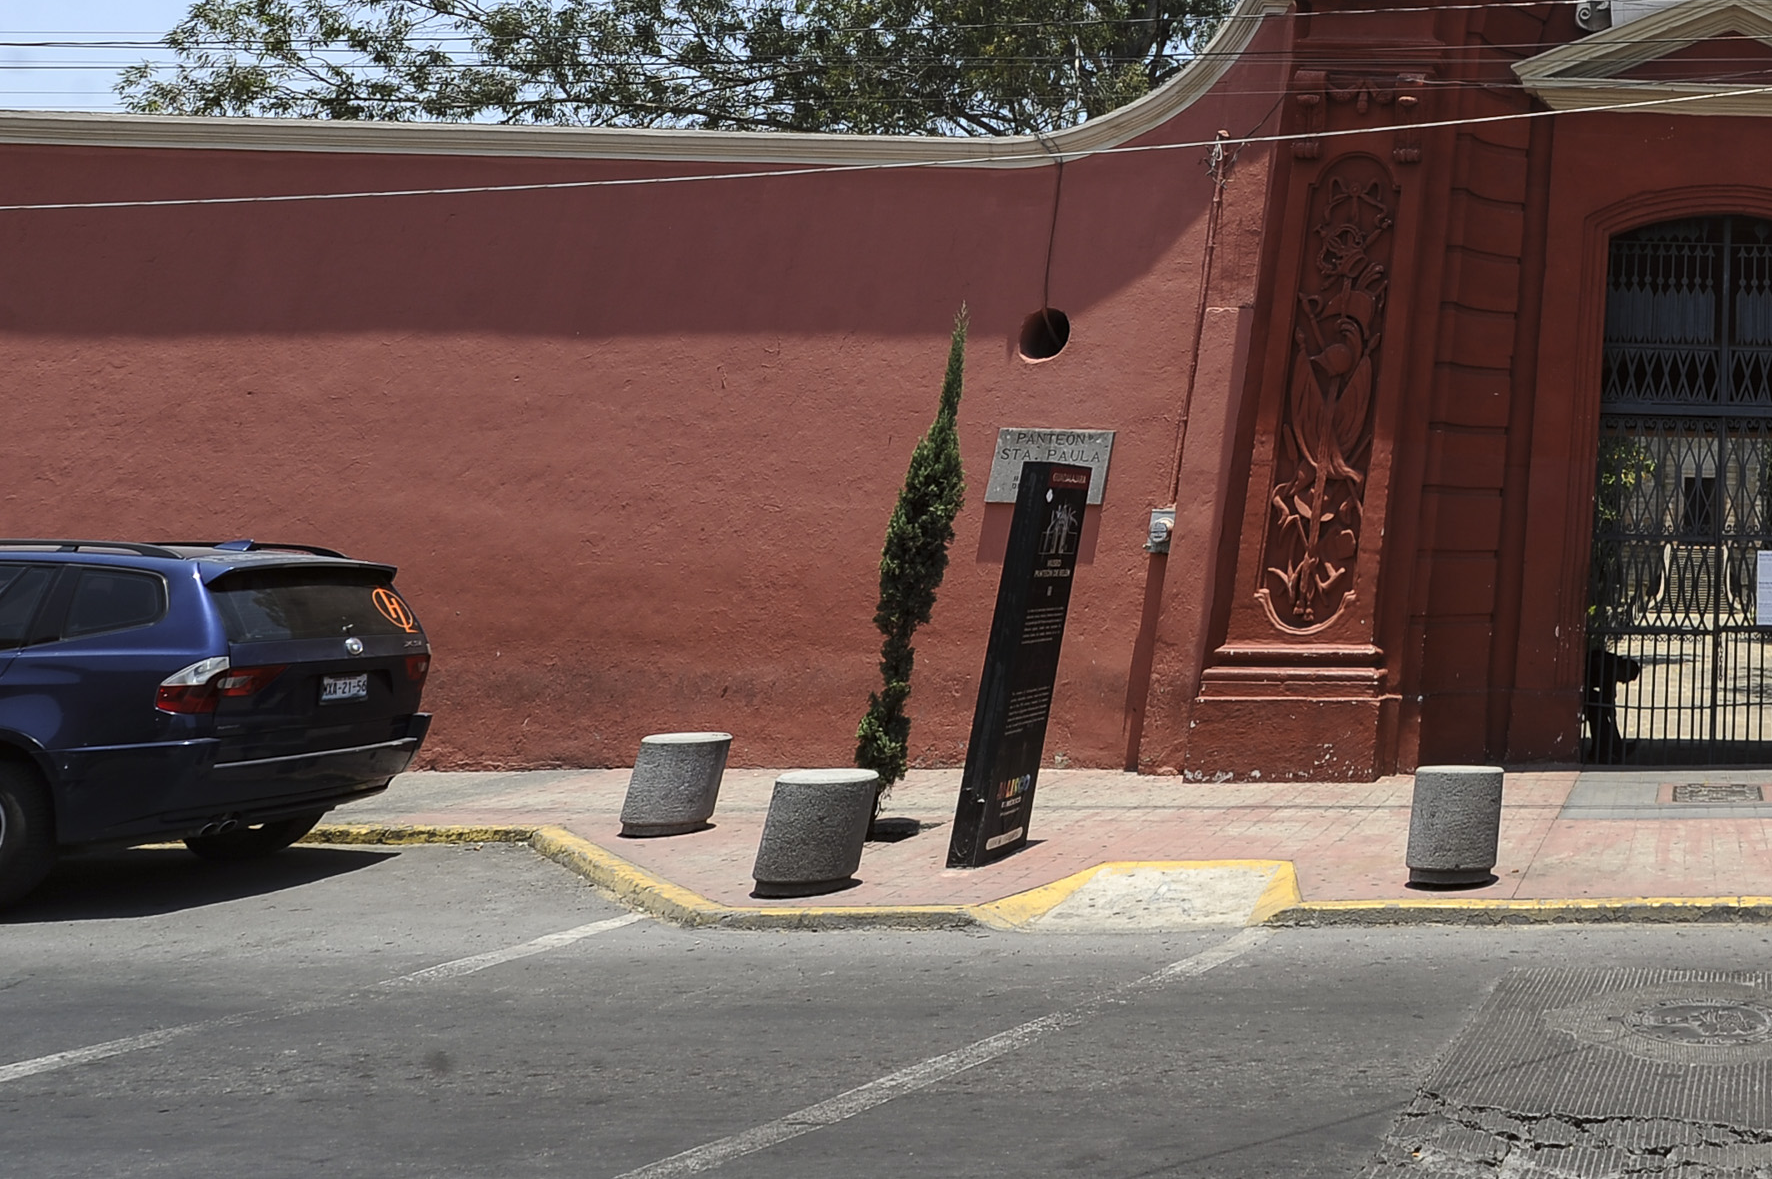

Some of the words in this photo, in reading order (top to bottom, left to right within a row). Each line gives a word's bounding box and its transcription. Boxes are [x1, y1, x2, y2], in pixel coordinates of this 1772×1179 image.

[1016, 431, 1086, 446] PANTEÓN
[1000, 448, 1038, 461] STA.
[1046, 449, 1101, 463] PAULA
